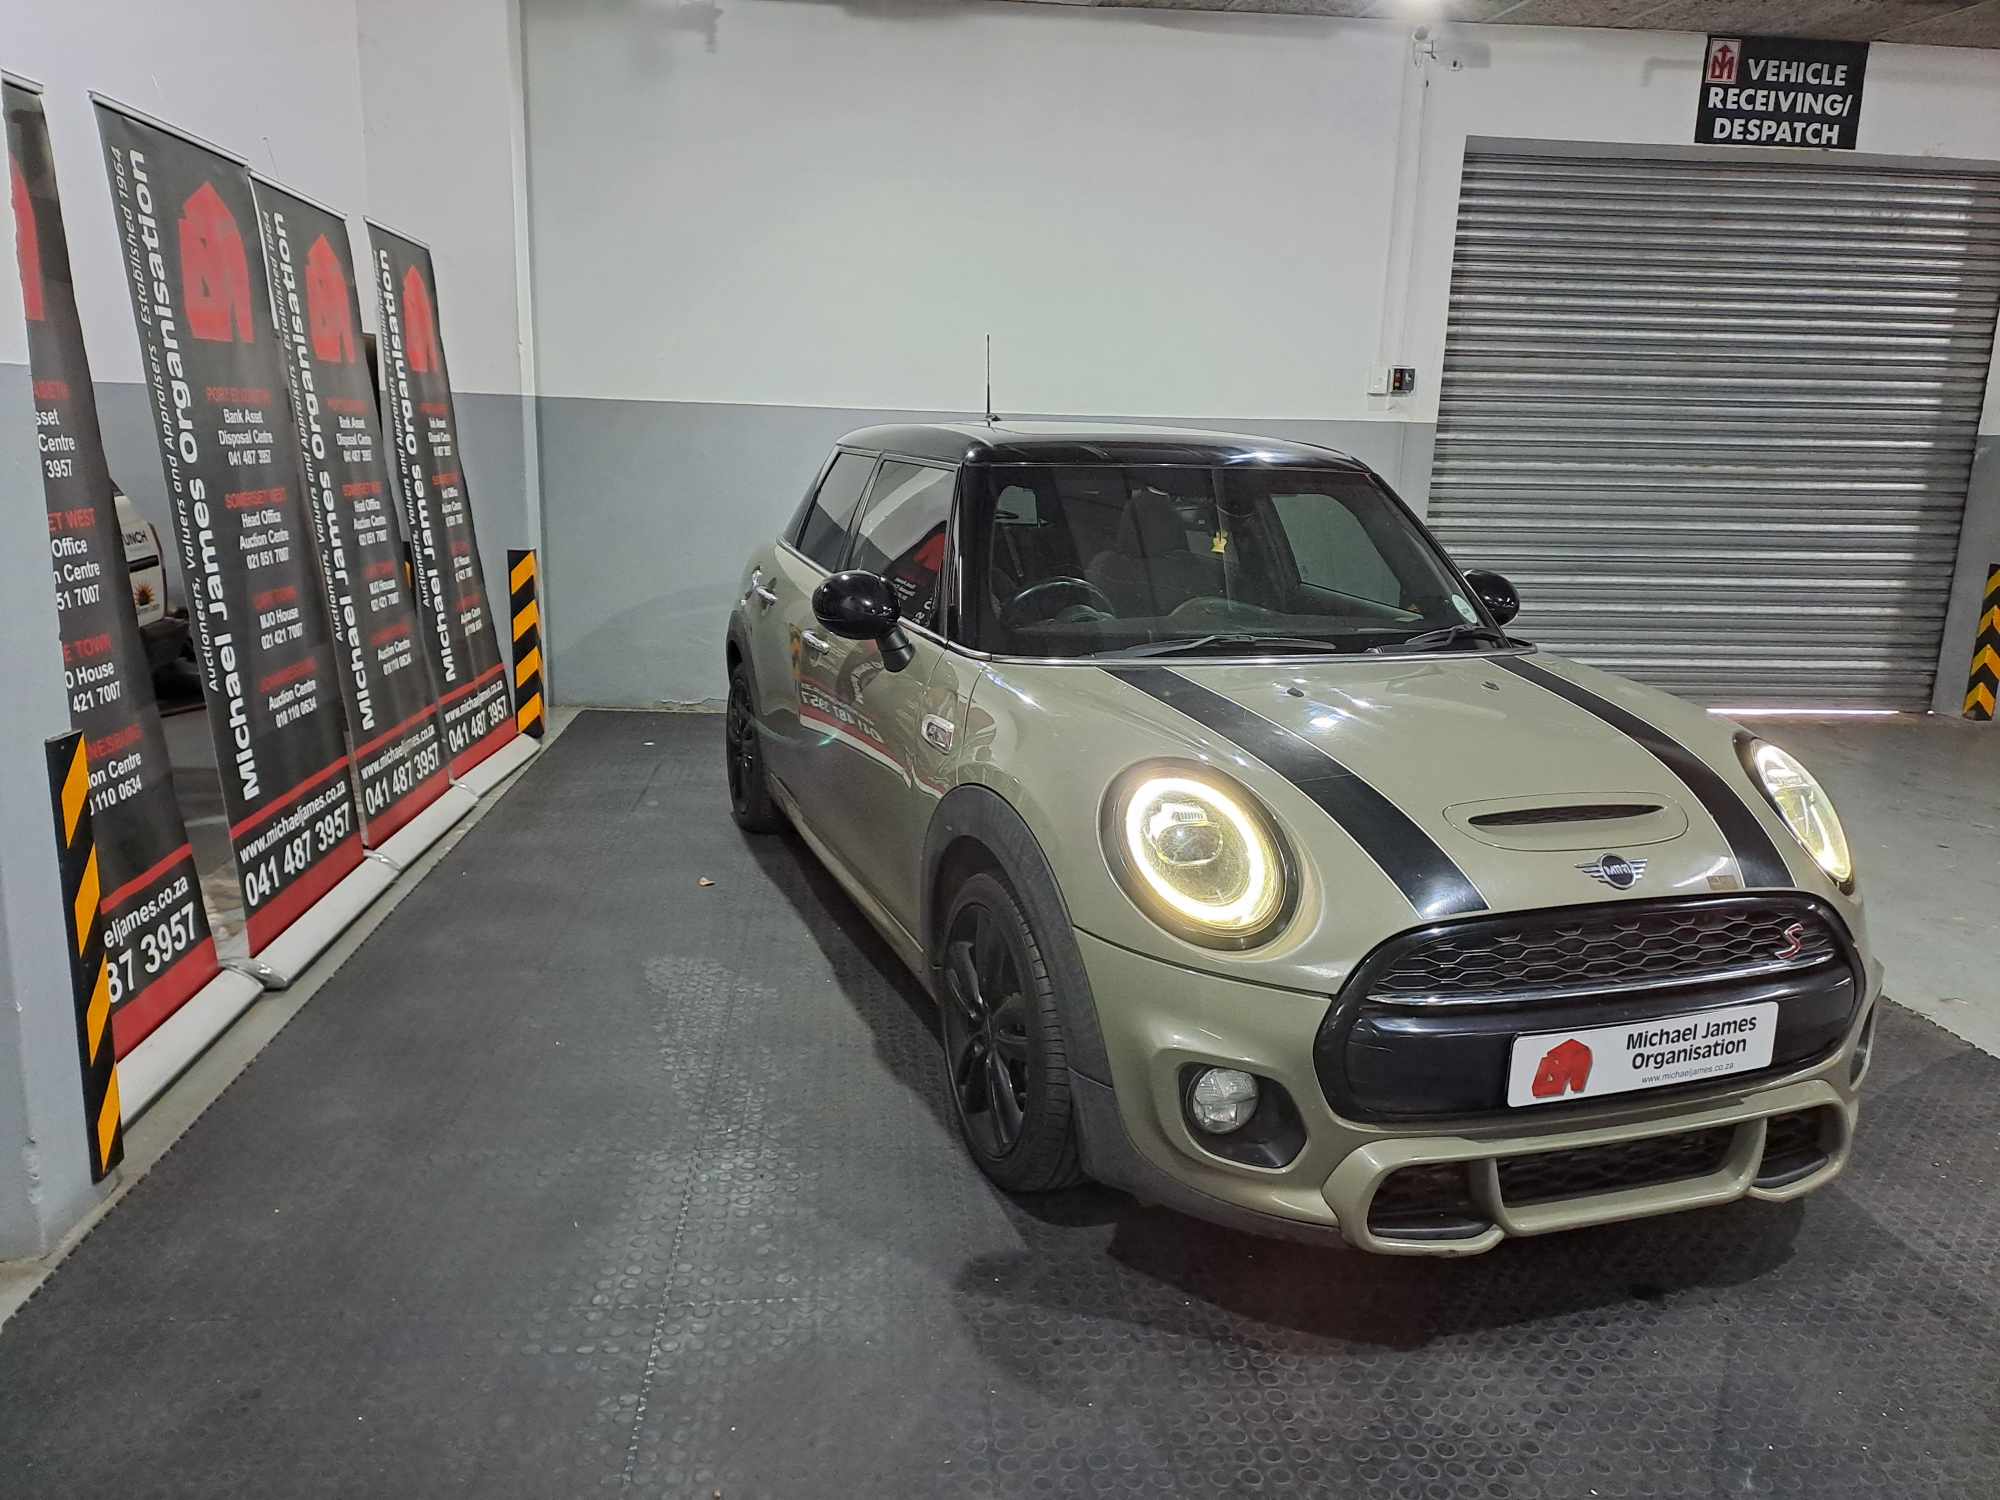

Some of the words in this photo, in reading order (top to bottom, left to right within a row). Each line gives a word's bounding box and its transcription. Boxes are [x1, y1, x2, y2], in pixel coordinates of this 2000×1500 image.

[1748, 58, 1848, 86] VEHICLE
[1707, 87, 1853, 118] RECEIVING/
[1712, 117, 1840, 145] DESPATCH
[111, 146, 129, 199] 1964
[120, 203, 152, 326] Established
[129, 149, 198, 464] Organisation
[274, 212, 325, 460] Organisation
[379, 249, 418, 456] Organisation
[36, 409, 60, 426] sset
[148, 343, 175, 450] Appraisers
[223, 408, 244, 424] Bank
[38, 433, 75, 452] Centre
[218, 429, 253, 448] Disposal
[45, 458, 72, 478] 3957
[166, 453, 183, 493] and
[302, 451, 315, 482] and
[177, 498, 196, 569] Valuers
[309, 486, 326, 543] Valuers
[319, 471, 349, 585] James
[411, 464, 436, 561] James
[52, 537, 88, 558] Office
[189, 478, 228, 621] James
[63, 561, 101, 582] Centre
[56, 590, 72, 611] 51
[74, 584, 100, 606] 7007
[426, 569, 457, 682] Michael
[75, 662, 114, 685] House
[339, 596, 375, 731] Michael
[73, 690, 95, 713] 421
[96, 680, 120, 704] 7007
[214, 633, 260, 800] Michael
[449, 722, 468, 752] 041
[470, 708, 486, 739] 487
[488, 695, 507, 726] 3957
[108, 752, 142, 779] Centre
[361, 724, 435, 780] www.michaeljames.co.za
[95, 787, 117, 811] 110
[118, 774, 142, 800] 0634
[365, 776, 390, 815] 041
[392, 763, 413, 797] 487
[414, 742, 440, 780] 3957
[240, 781, 346, 864] www.michaeljames.co.za
[245, 856, 280, 907] 041
[283, 830, 311, 875] 487
[315, 802, 351, 852] 3957
[103, 876, 189, 949] eljames.co.za
[106, 949, 135, 1003] 87
[141, 902, 197, 973] 3957
[1774, 923, 1804, 960] S
[1626, 1023, 1698, 1051] Michael
[1701, 1015, 1757, 1041] James
[1631, 1036, 1747, 1071] Organisation
[1641, 1061, 1734, 1084] www.michaeljames.co.za
